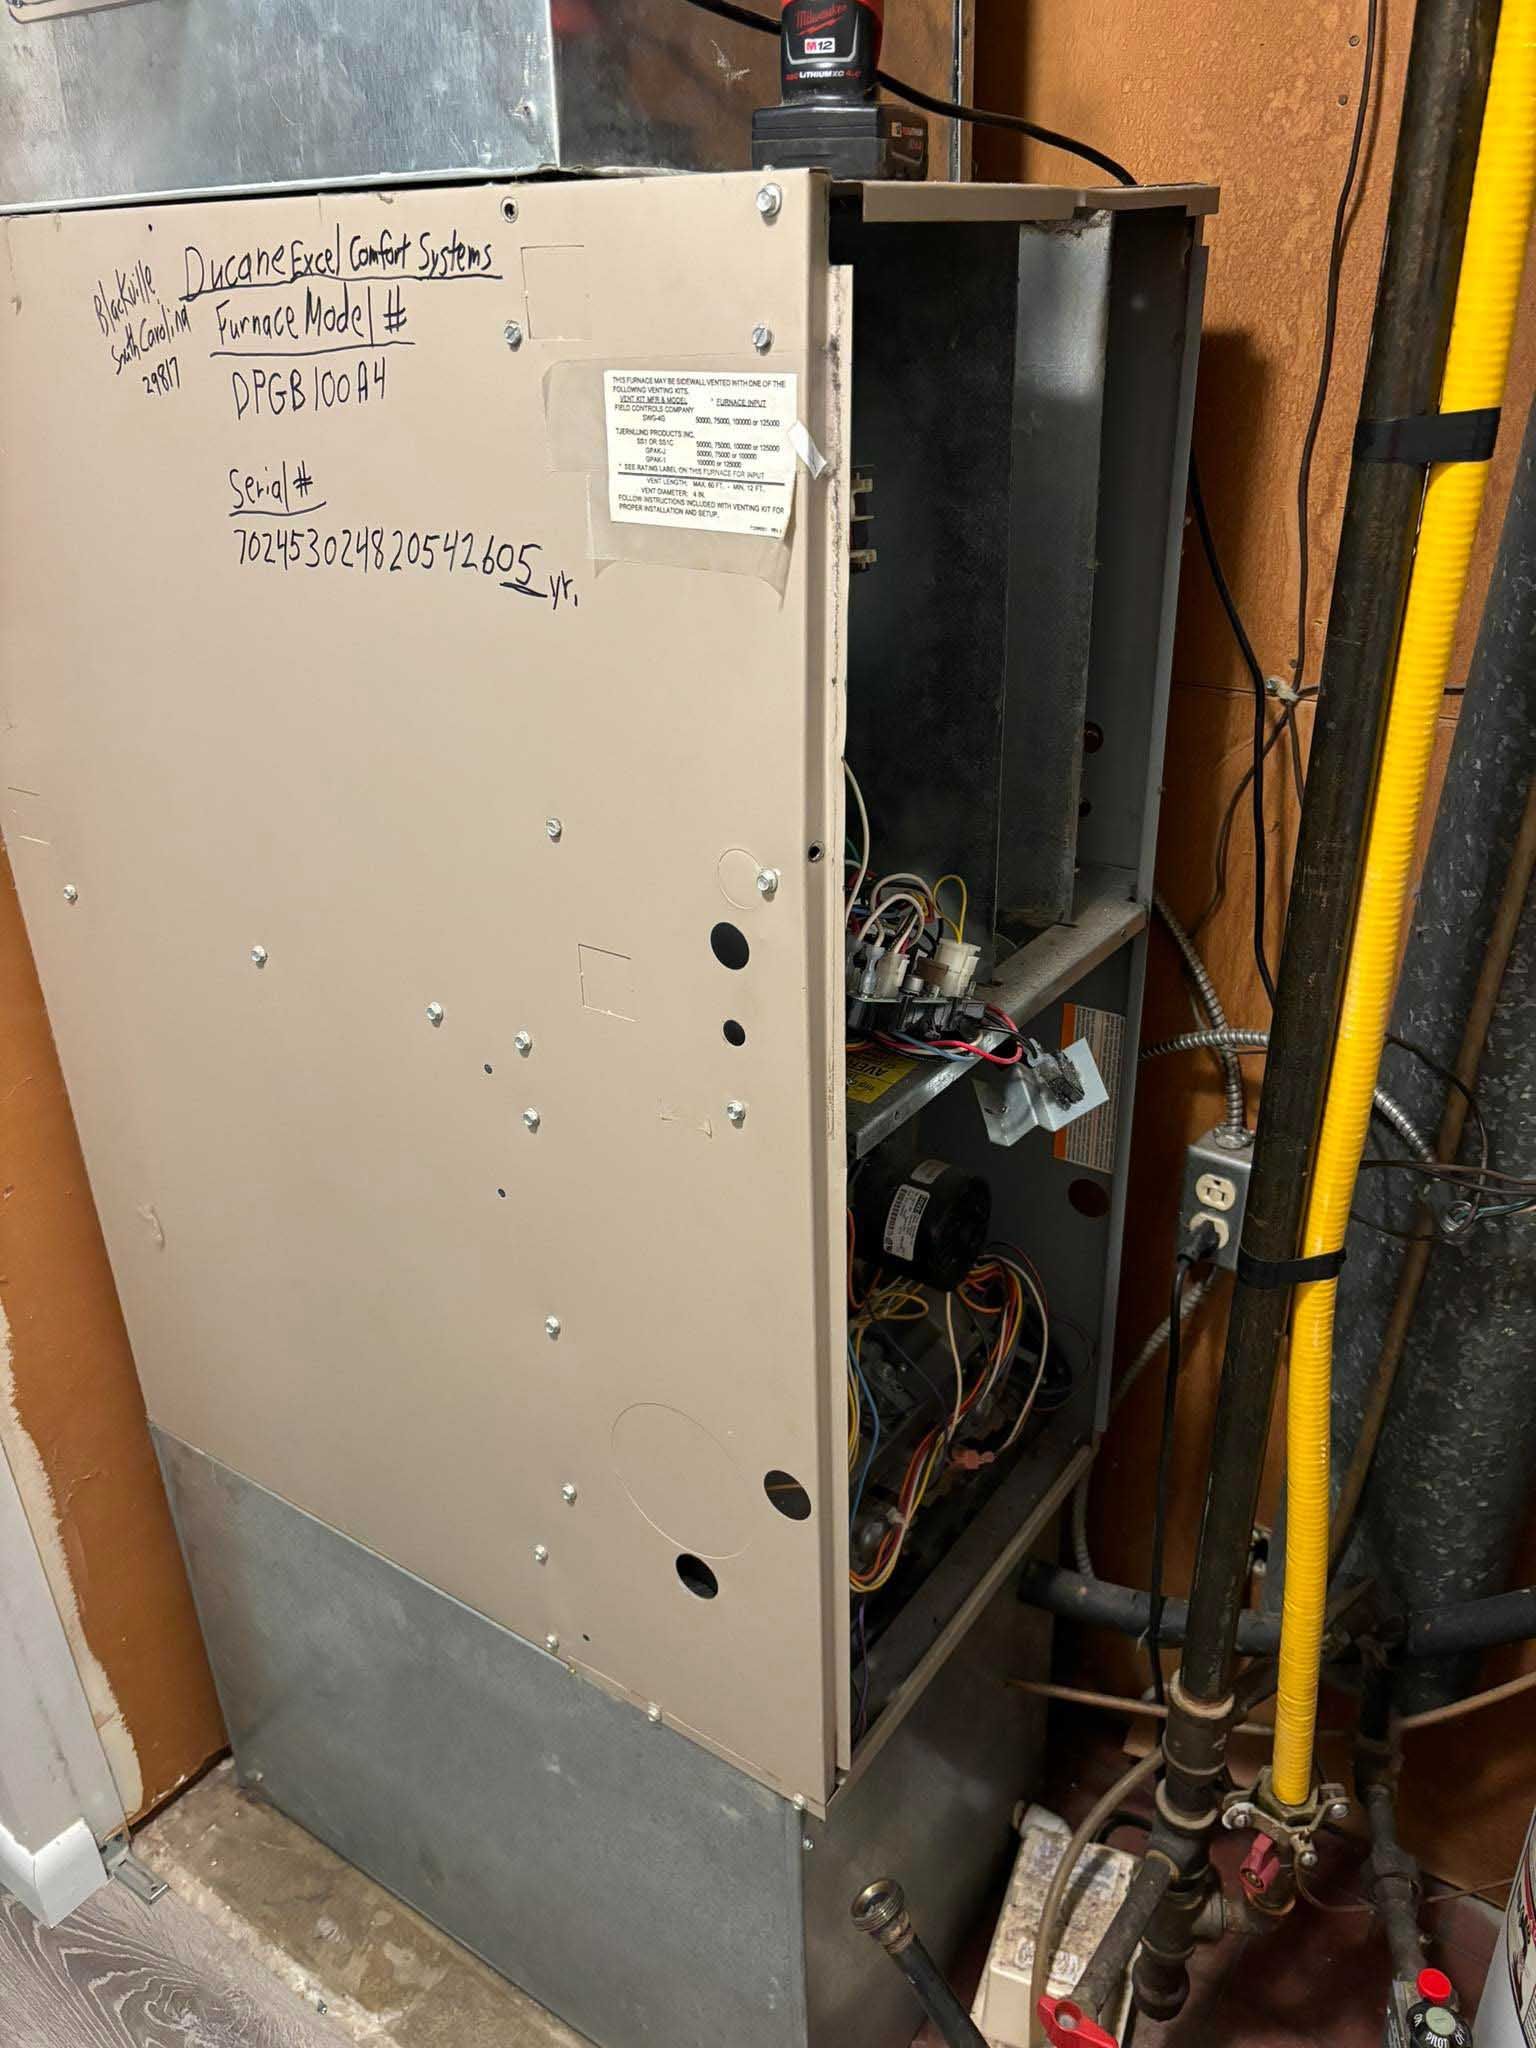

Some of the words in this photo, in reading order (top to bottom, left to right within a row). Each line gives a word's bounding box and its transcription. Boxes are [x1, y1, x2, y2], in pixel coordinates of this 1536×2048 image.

[806, 40, 833, 50] M12
[184, 245, 286, 302] Ducane
[290, 222, 341, 277] Excel
[349, 228, 412, 272] Comfort
[417, 229, 492, 279] Systems
[215, 299, 299, 346] Furnace
[304, 281, 375, 347] Model
[382, 284, 408, 335] #
[139, 303, 192, 352] Carolina
[141, 356, 181, 397] 29817
[612, 376, 626, 384] THIS
[626, 376, 653, 385] FURNACE
[653, 377, 666, 385] MAY
[667, 377, 676, 385] BE
[676, 377, 706, 386] SIDEWALL
[706, 378, 731, 387] VENTED
[731, 379, 748, 387] WITH
[748, 379, 762, 388] ONE
[762, 379, 772, 388] OF
[772, 380, 786, 389] THE
[231, 356, 386, 421] DPGB100A4
[612, 385, 647, 394] FOLLOWING
[647, 386, 674, 394] VENTING
[619, 395, 635, 404] VENT
[636, 395, 645, 404] KIT
[666, 396, 689, 405] MODEL
[716, 398, 746, 407] FURNACE
[747, 399, 767, 408] INPUT
[614, 403, 631, 412] FIELD
[631, 404, 664, 413] CONTROLS
[664, 405, 696, 414] COMPANY
[649, 428, 682, 438] PRODUCTS
[624, 462, 636, 471] SEE
[636, 463, 659, 473] RATING
[659, 464, 678, 474] LABEL
[678, 466, 688, 474] ON
[688, 466, 703, 475] THIS
[703, 467, 732, 478] FURNACE
[732, 469, 746, 479] FOR
[746, 471, 765, 480] INPUT
[228, 460, 290, 513] Serial
[292, 459, 315, 499] #
[645, 476, 662, 485] VENT
[640, 486, 657, 495] VENT
[617, 493, 643, 503] FOLLOW
[643, 495, 686, 506] INSTRUCTIONS
[686, 499, 717, 509] INCLUDED
[716, 501, 732, 511] WITH
[732, 502, 760, 513] VENTING
[760, 505, 772, 513] KIT
[772, 505, 785, 515] FOR
[618, 502, 643, 512] PROPER
[643, 504, 685, 515] INSTALLATION
[685, 508, 698, 517] AND
[1424, 2030, 1449, 2048] PILOT
